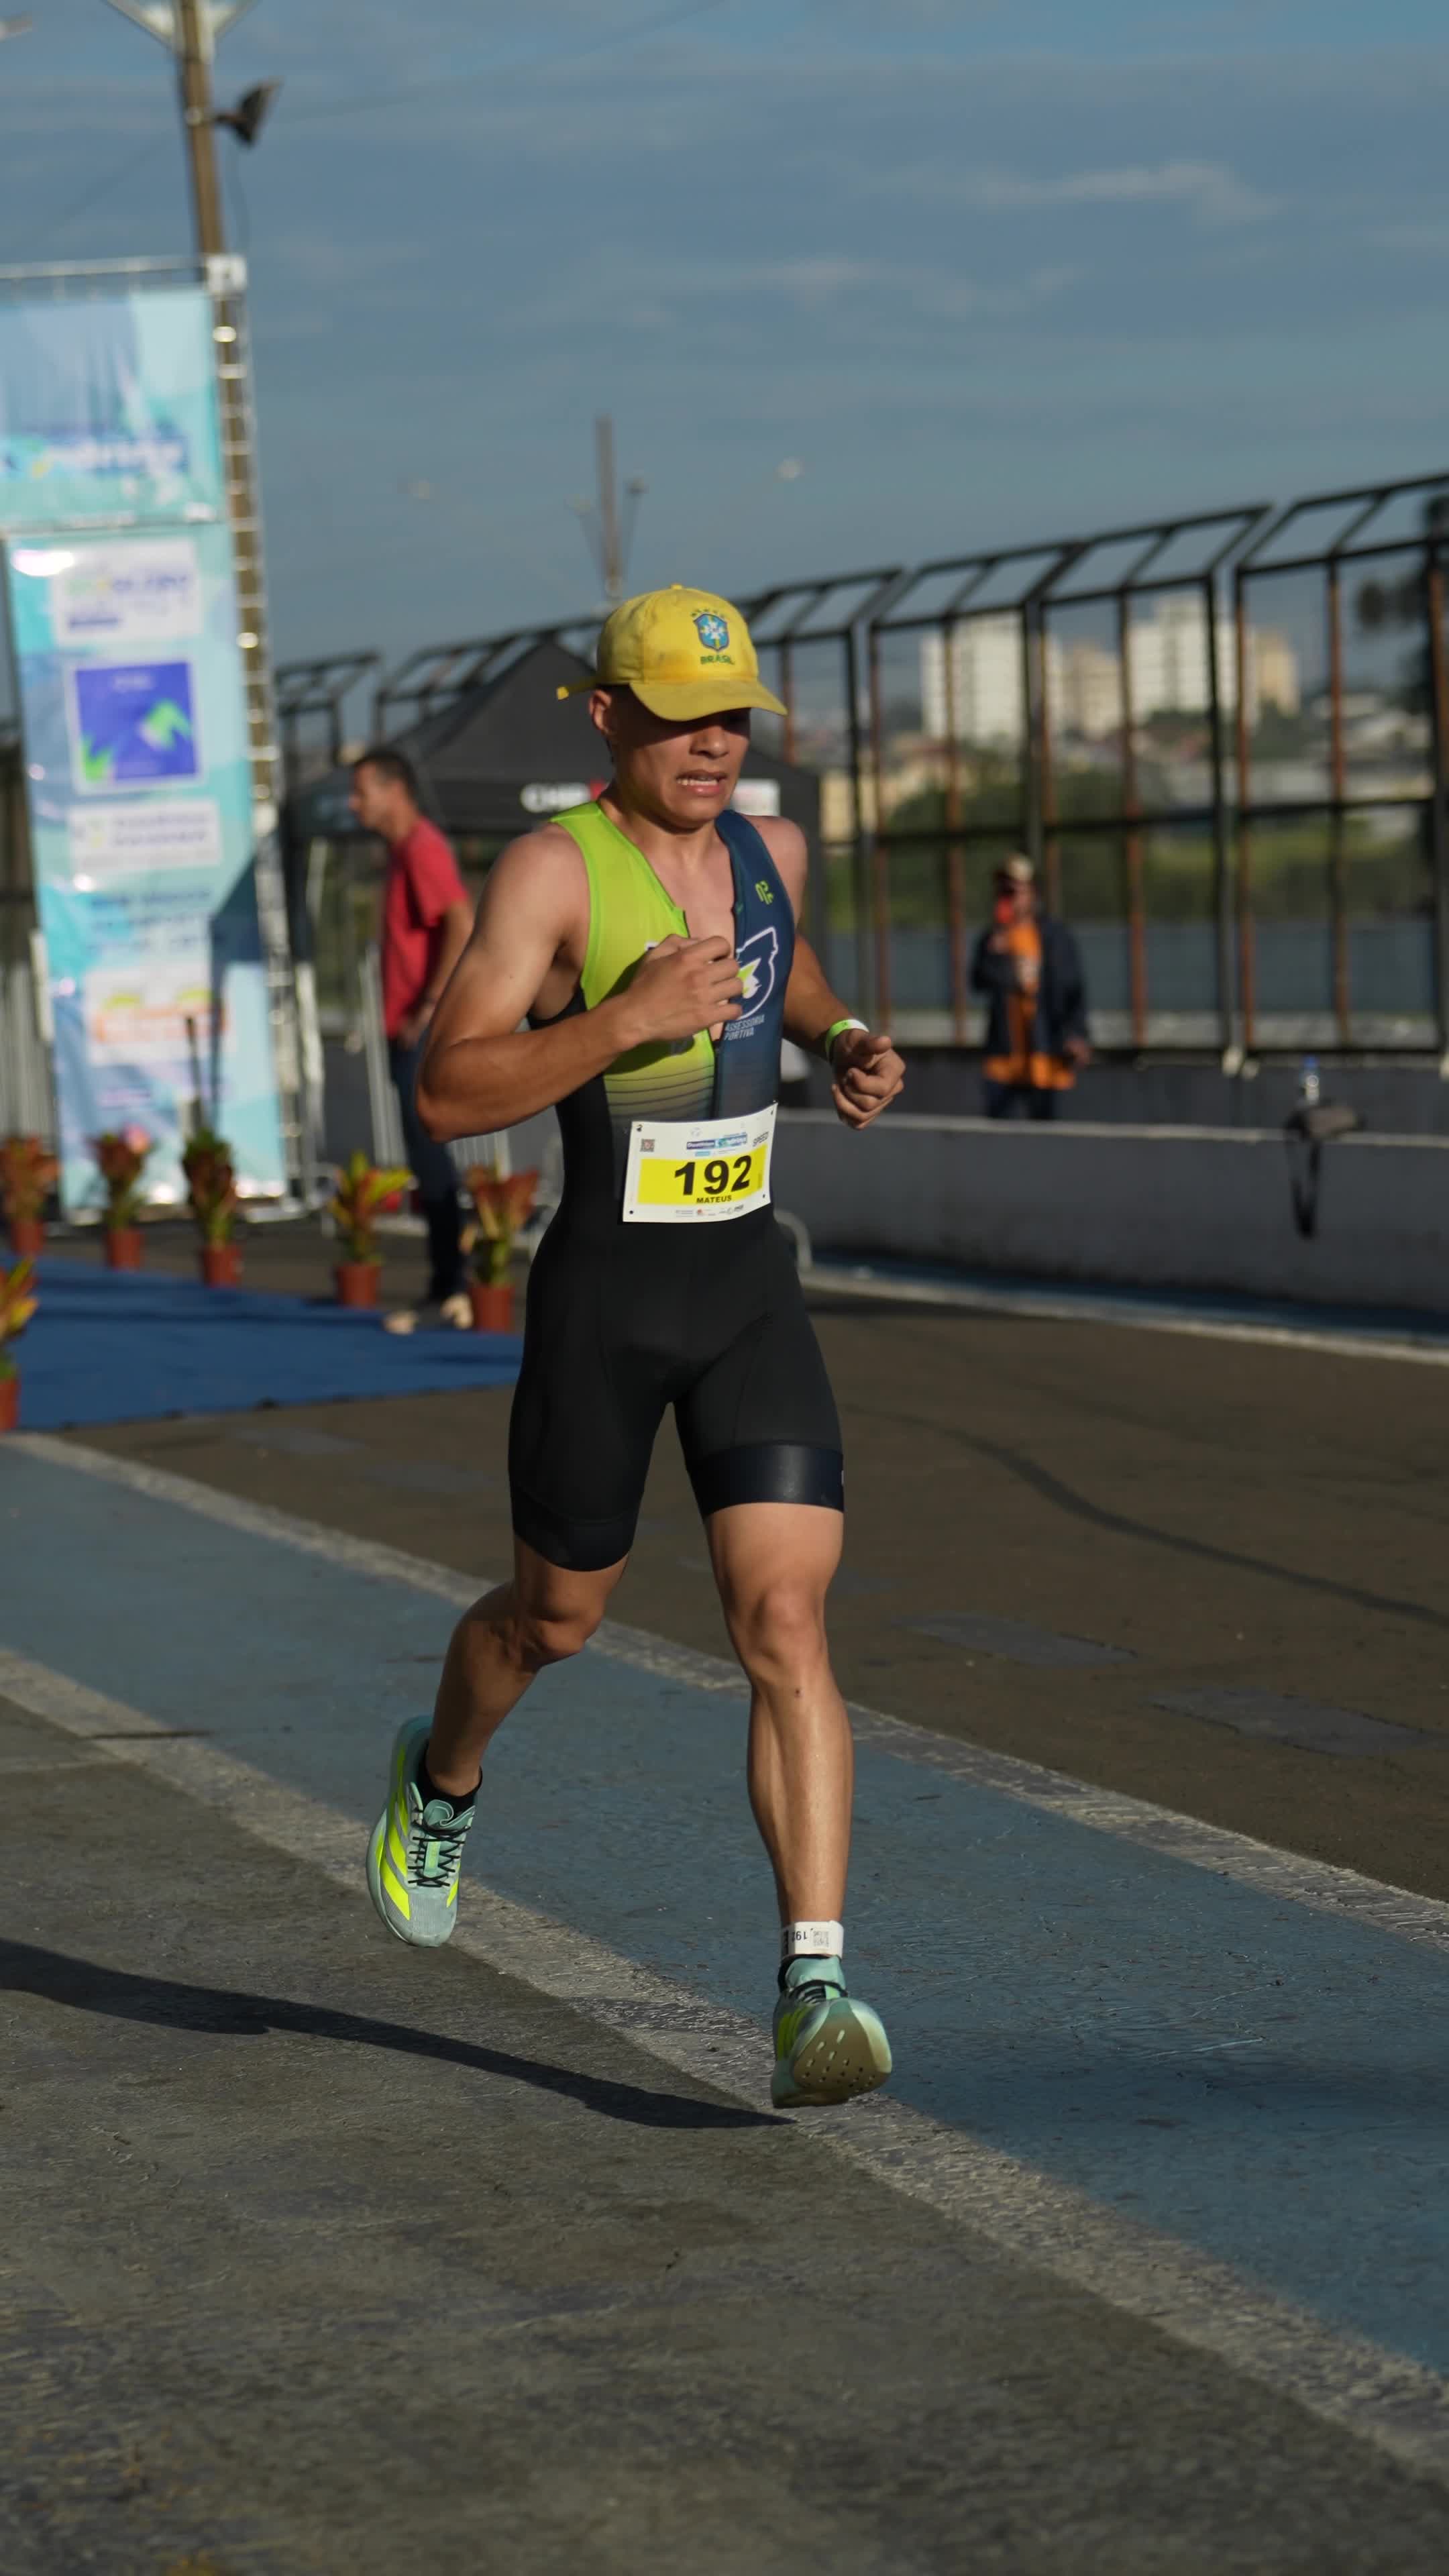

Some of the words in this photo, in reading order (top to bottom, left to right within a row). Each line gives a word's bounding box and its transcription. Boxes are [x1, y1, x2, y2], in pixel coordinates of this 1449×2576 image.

[752, 1131, 769, 1147] SPEED
[675, 1155, 752, 1196] 192
[696, 1195, 732, 1203] MATEUS
